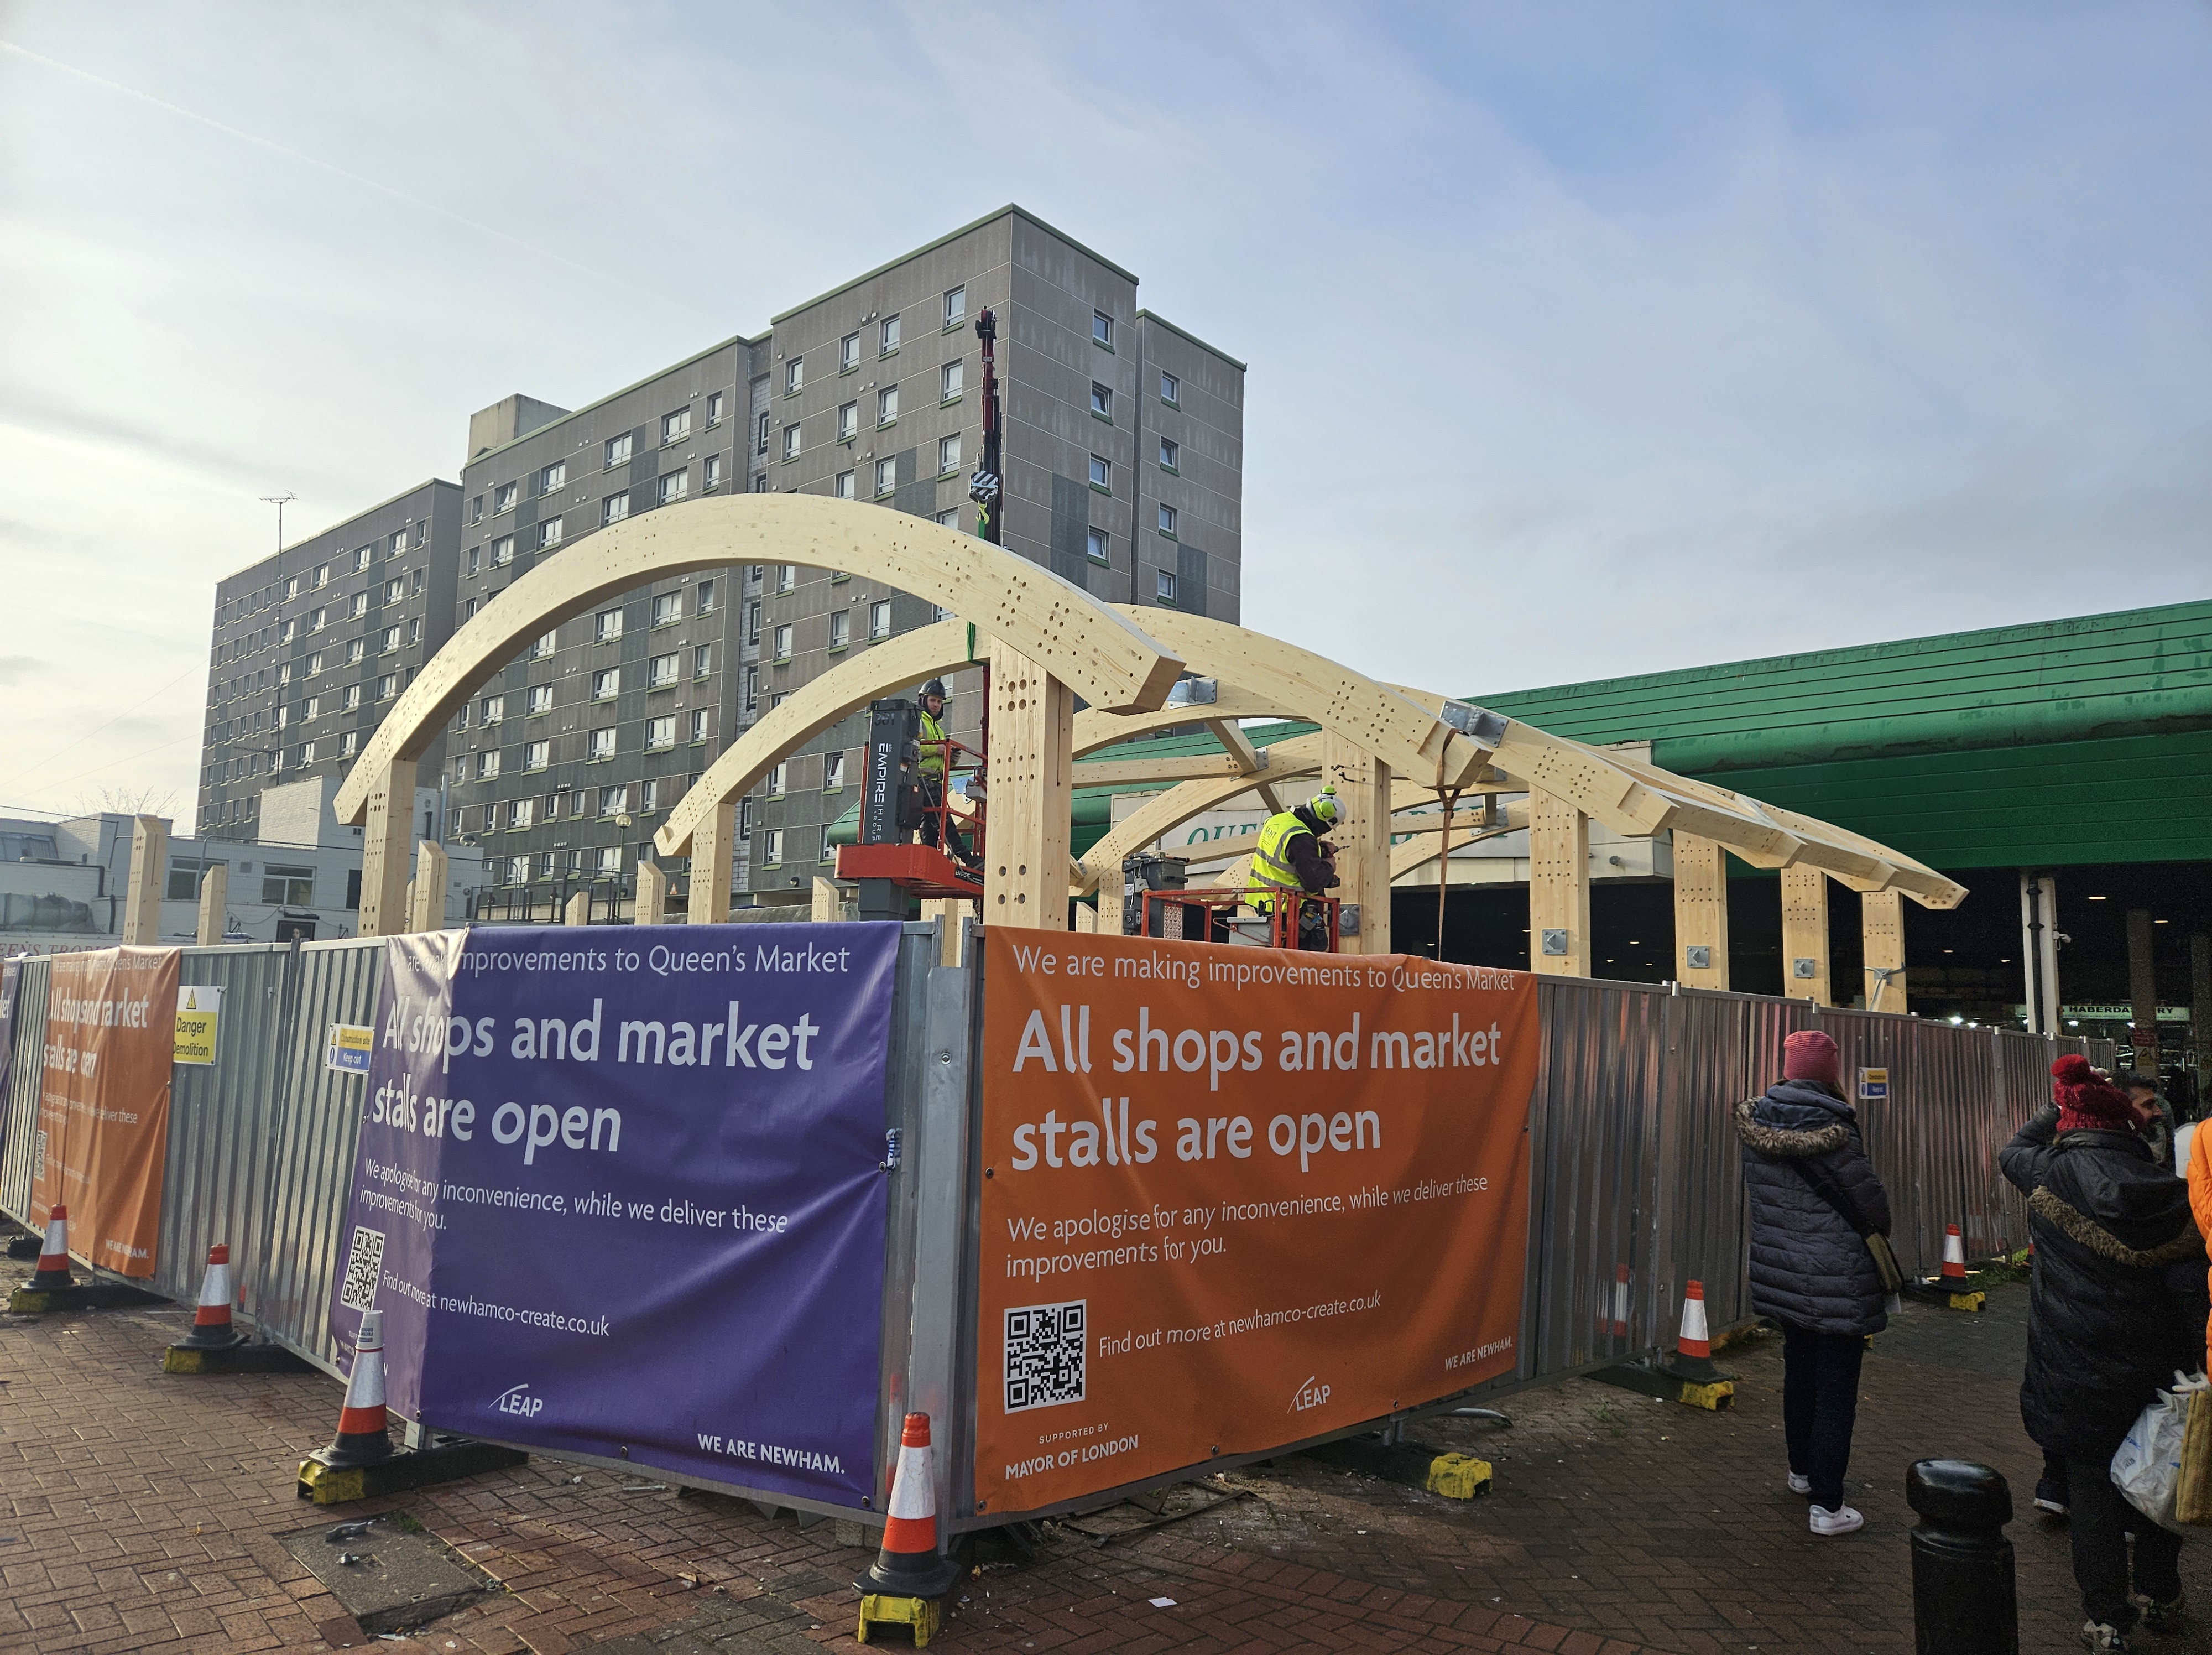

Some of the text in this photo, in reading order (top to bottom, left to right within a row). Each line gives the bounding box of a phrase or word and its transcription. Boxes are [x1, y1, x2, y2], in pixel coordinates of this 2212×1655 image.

[874, 743, 888, 803] EMPIRE
[133, 954, 161, 970] Market
[462, 948, 606, 978] mprovements
[615, 948, 639, 971] to
[649, 945, 745, 976] Queen's
[755, 941, 851, 972] Market
[1013, 945, 1515, 992] We are making improvements to Queen's Market
[101, 987, 149, 1028] arket
[176, 1017, 207, 1037] Danger
[2069, 1006, 2173, 1014] HABERDARY
[173, 1041, 208, 1057] Demolition
[382, 995, 820, 1074] All shops and market
[1012, 1005, 1502, 1091] All shops and market
[343, 1052, 362, 1066] Keep out
[119, 1107, 138, 1124] these
[372, 1072, 622, 1165] stalls are open
[1011, 1097, 1381, 1172] stalls are open
[359, 1184, 415, 1219] improvements
[422, 1210, 447, 1231] you.
[366, 1158, 379, 1178] We
[380, 1163, 413, 1192] apologise
[422, 1180, 439, 1204] any
[443, 1179, 567, 1216] inconvenience,
[574, 1190, 622, 1217] while
[628, 1202, 654, 1221] we
[660, 1198, 726, 1227] deliver
[732, 1205, 789, 1233] these
[1007, 1174, 1488, 1245] We apologise for any inconvenience, while we deliver these
[1006, 1236, 1227, 1283] improvements for you.
[383, 1269, 609, 1336] Find out more at newhamco-create.co.uk
[1099, 1289, 1381, 1357] Find out more at newhamco-create.co.uk
[1445, 1336, 1513, 1371] WE ARE NEWHAM.
[499, 1394, 543, 1418] LEAP
[1296, 1385, 1331, 1411] LEAP
[697, 1433, 845, 1475] WE ARE NEWHAM.
[1039, 1422, 1108, 1444] SUPPORTED BY
[1005, 1434, 1138, 1480] MAYOR OF LONDON
